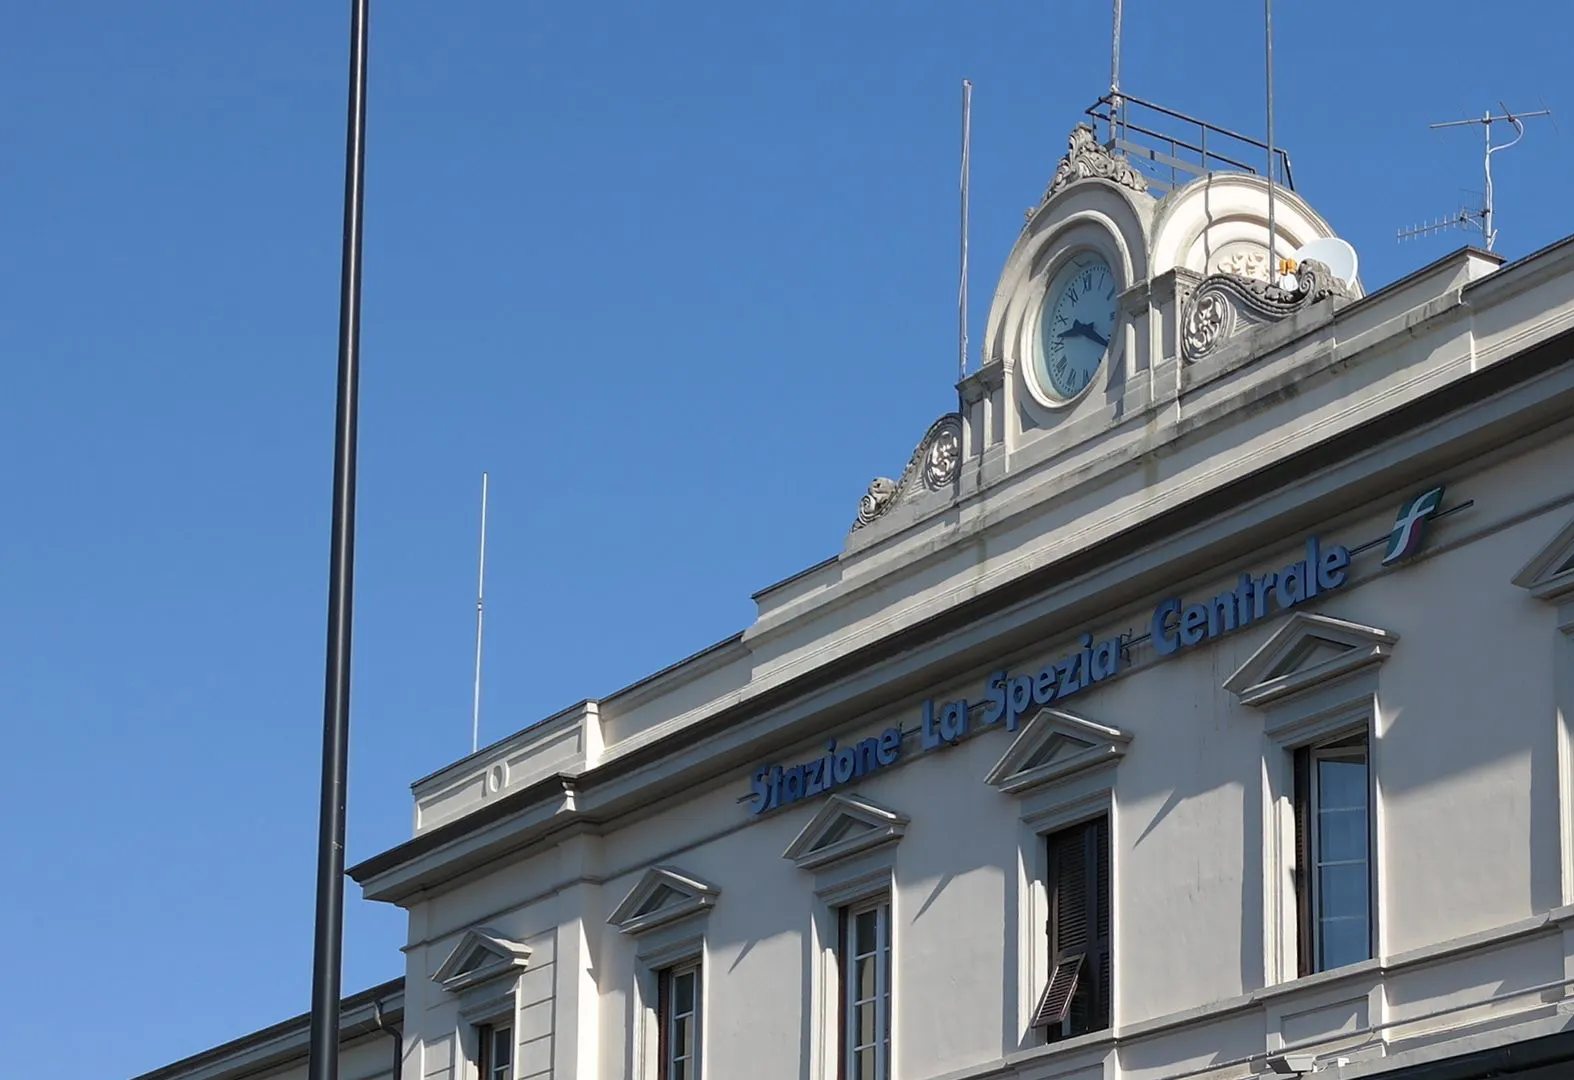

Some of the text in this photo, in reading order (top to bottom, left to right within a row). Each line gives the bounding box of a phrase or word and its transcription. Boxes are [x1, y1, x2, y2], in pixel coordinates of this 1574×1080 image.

[750, 727, 900, 814] Stazione
[921, 699, 968, 750] La
[983, 631, 1120, 732] Spezia
[1150, 534, 1350, 656] Centrale
